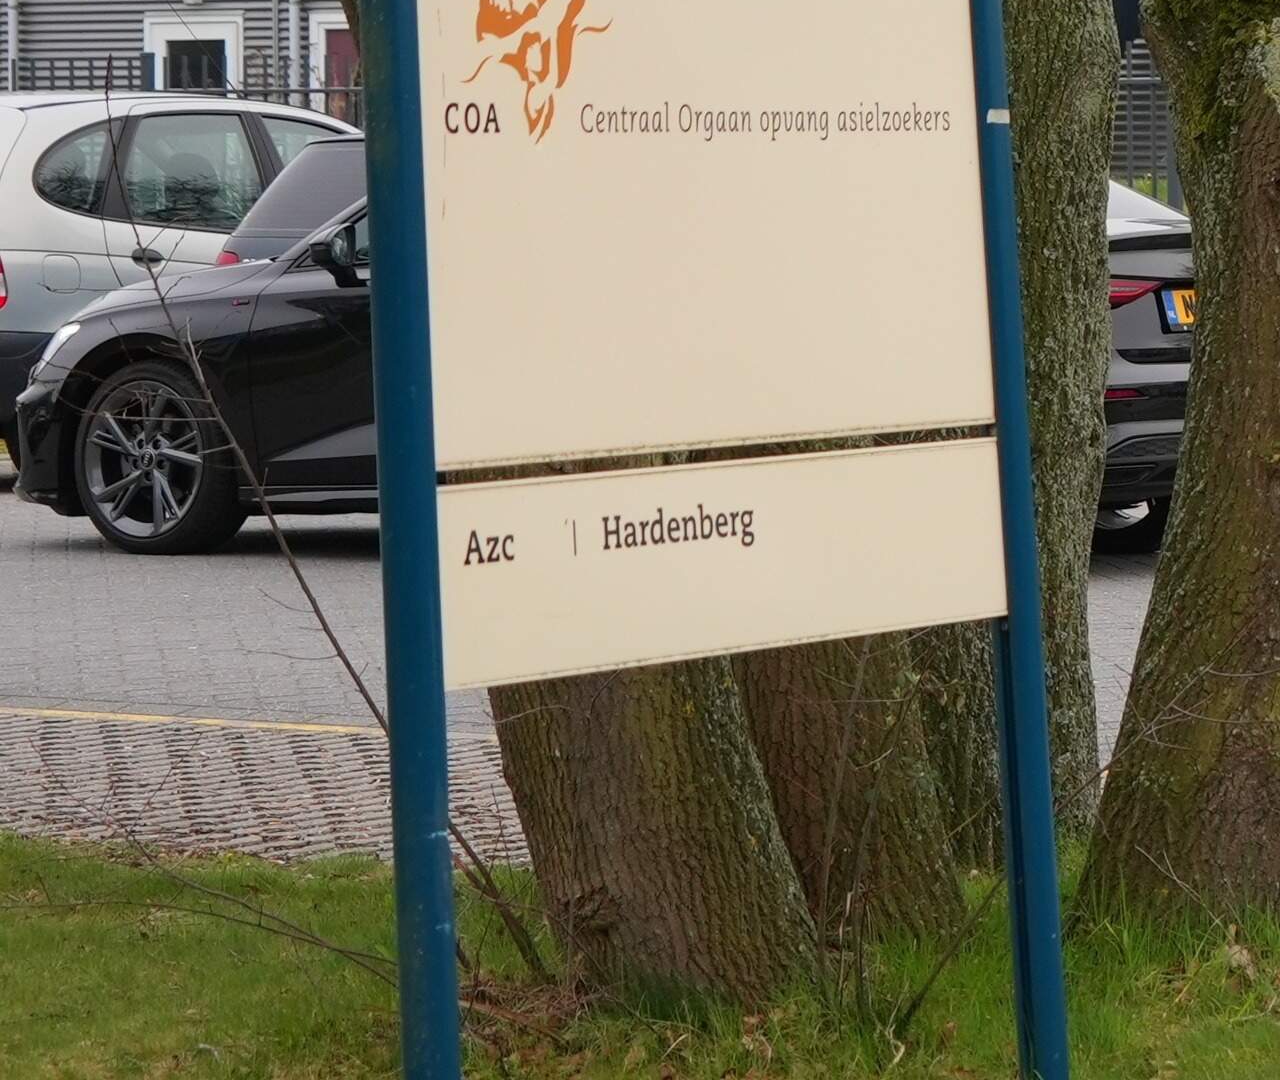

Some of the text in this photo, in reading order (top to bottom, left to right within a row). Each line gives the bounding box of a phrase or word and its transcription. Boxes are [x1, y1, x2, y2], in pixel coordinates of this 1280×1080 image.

[444, 101, 951, 142] COA Centraal Orgaan opvang asielzoekers
[463, 503, 755, 566] Azc Hardenberg
